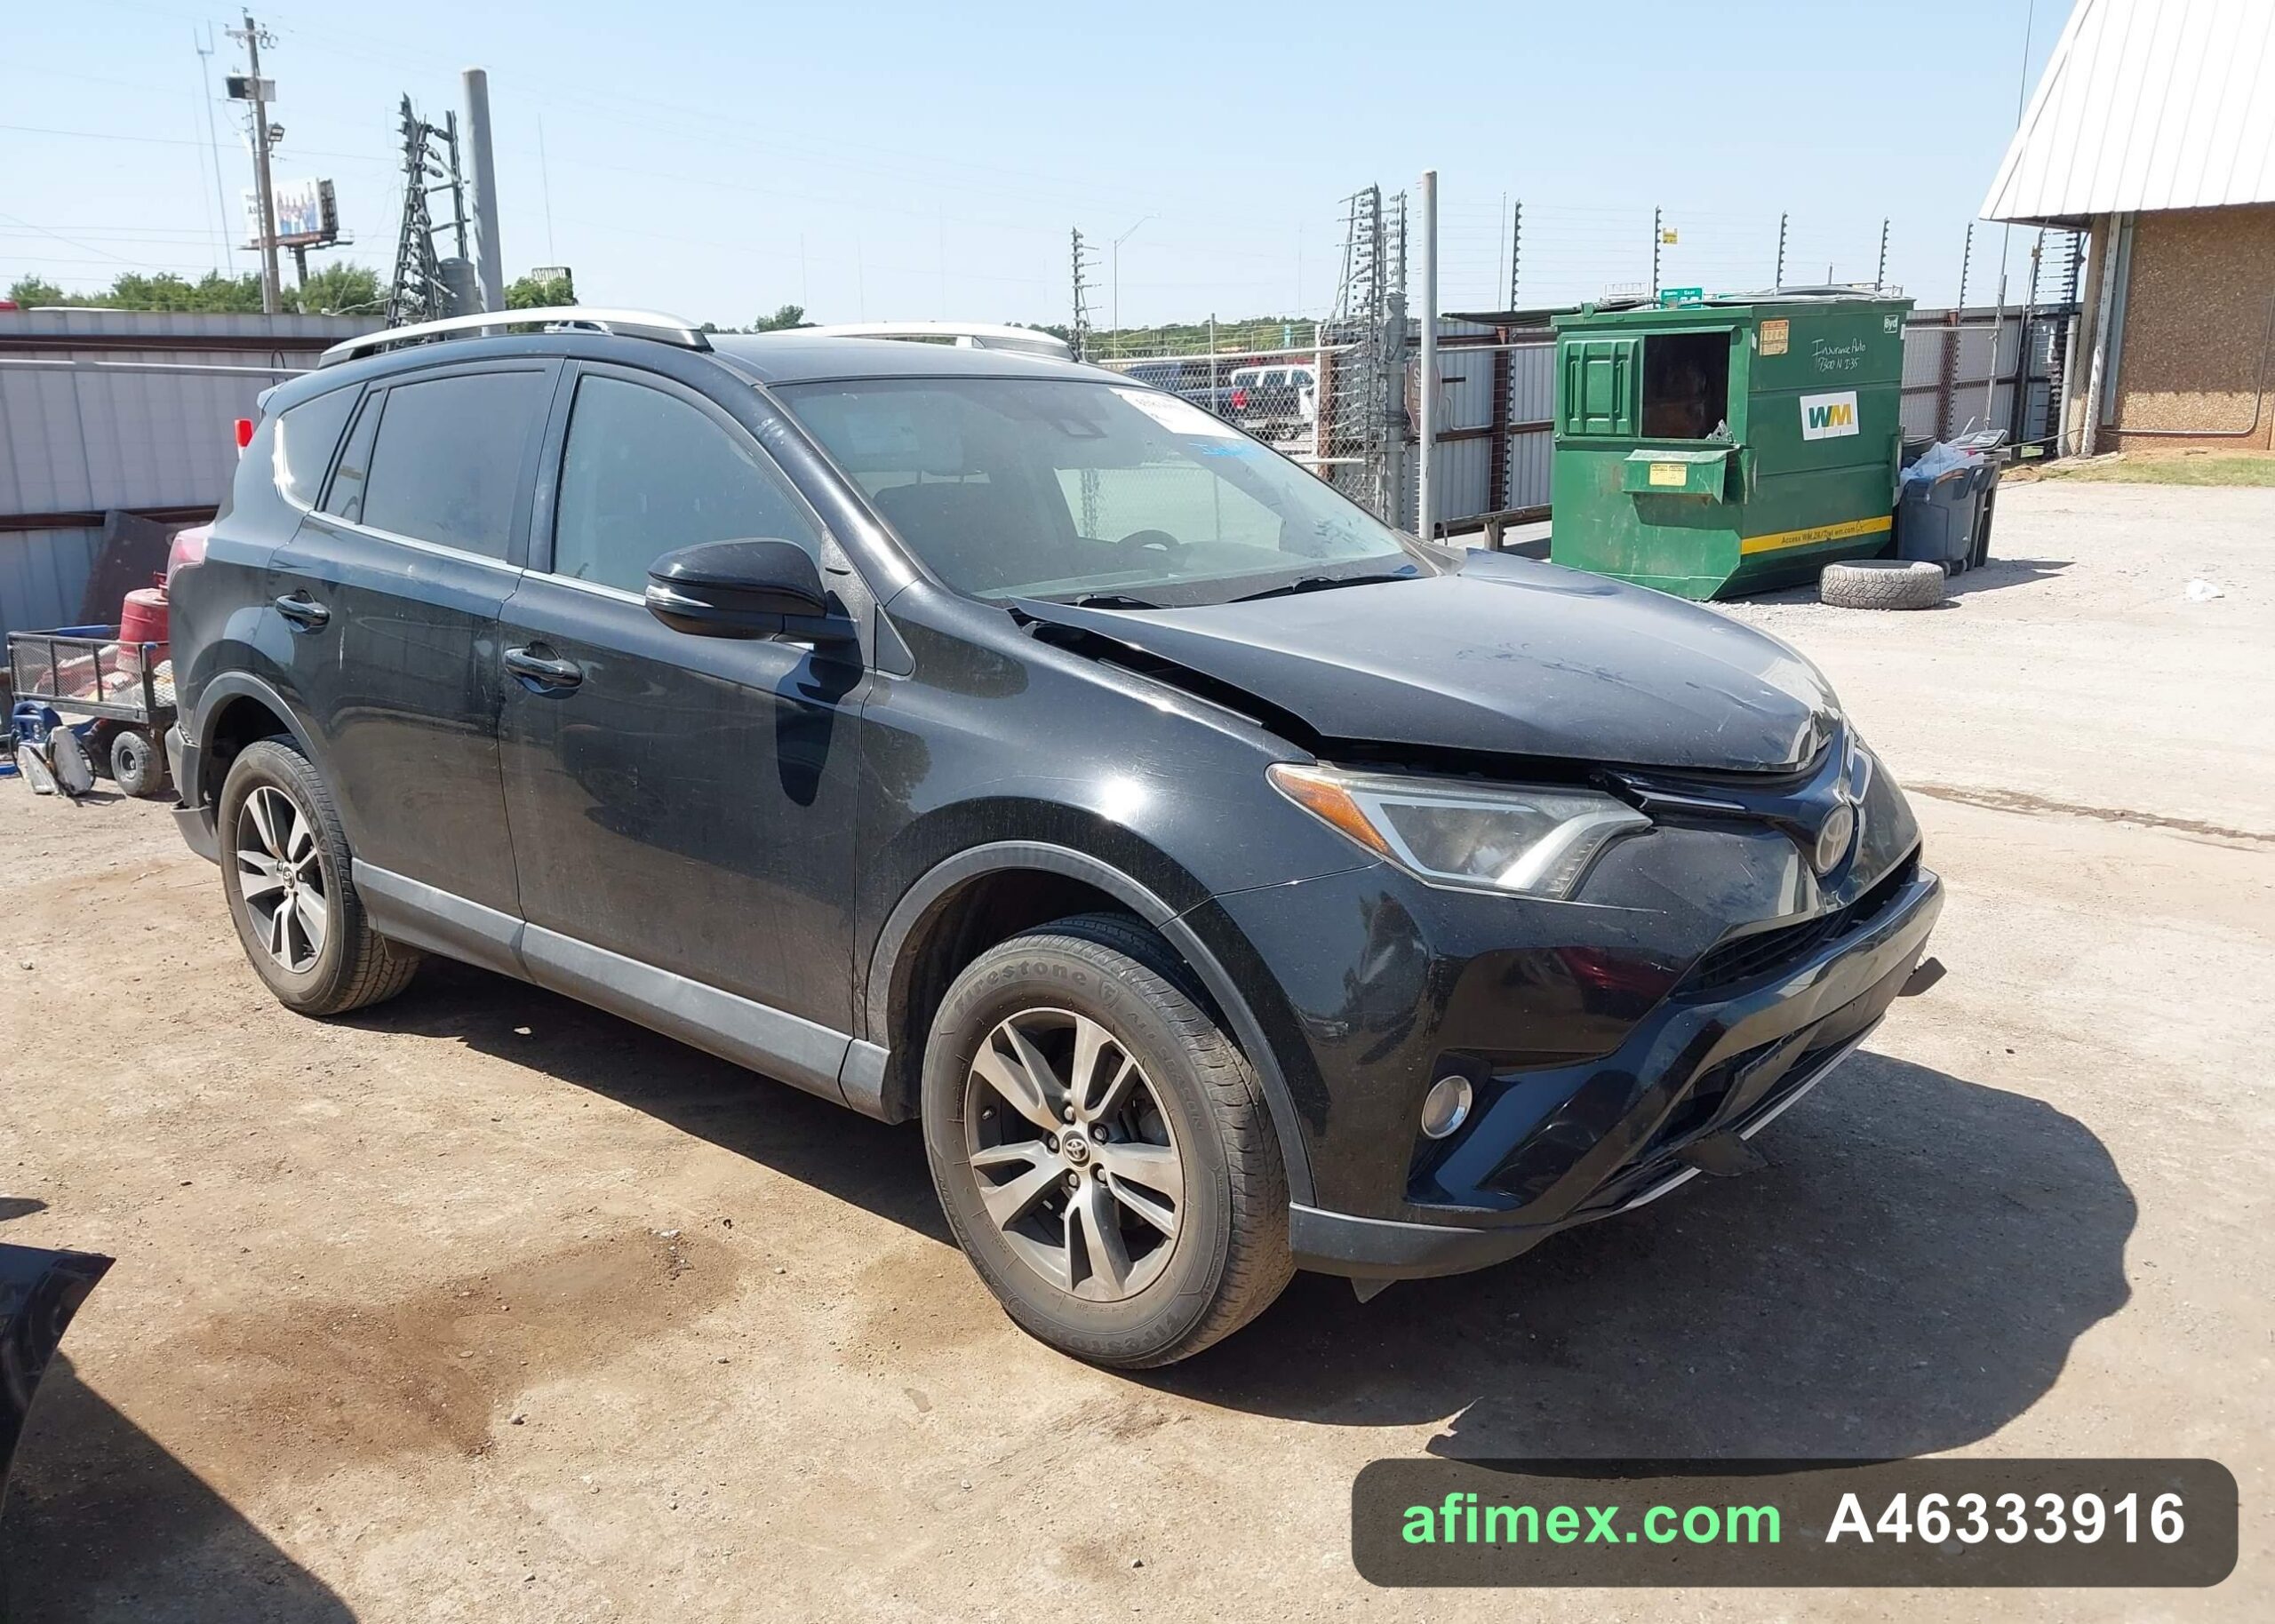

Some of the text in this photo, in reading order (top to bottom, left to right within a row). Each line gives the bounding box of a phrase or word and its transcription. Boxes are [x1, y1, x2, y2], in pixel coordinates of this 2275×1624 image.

[1851, 338, 1866, 354] Auto
[1836, 357, 1842, 369] N
[1808, 403, 1852, 429] WM
[954, 960, 1087, 1015] Firestone
